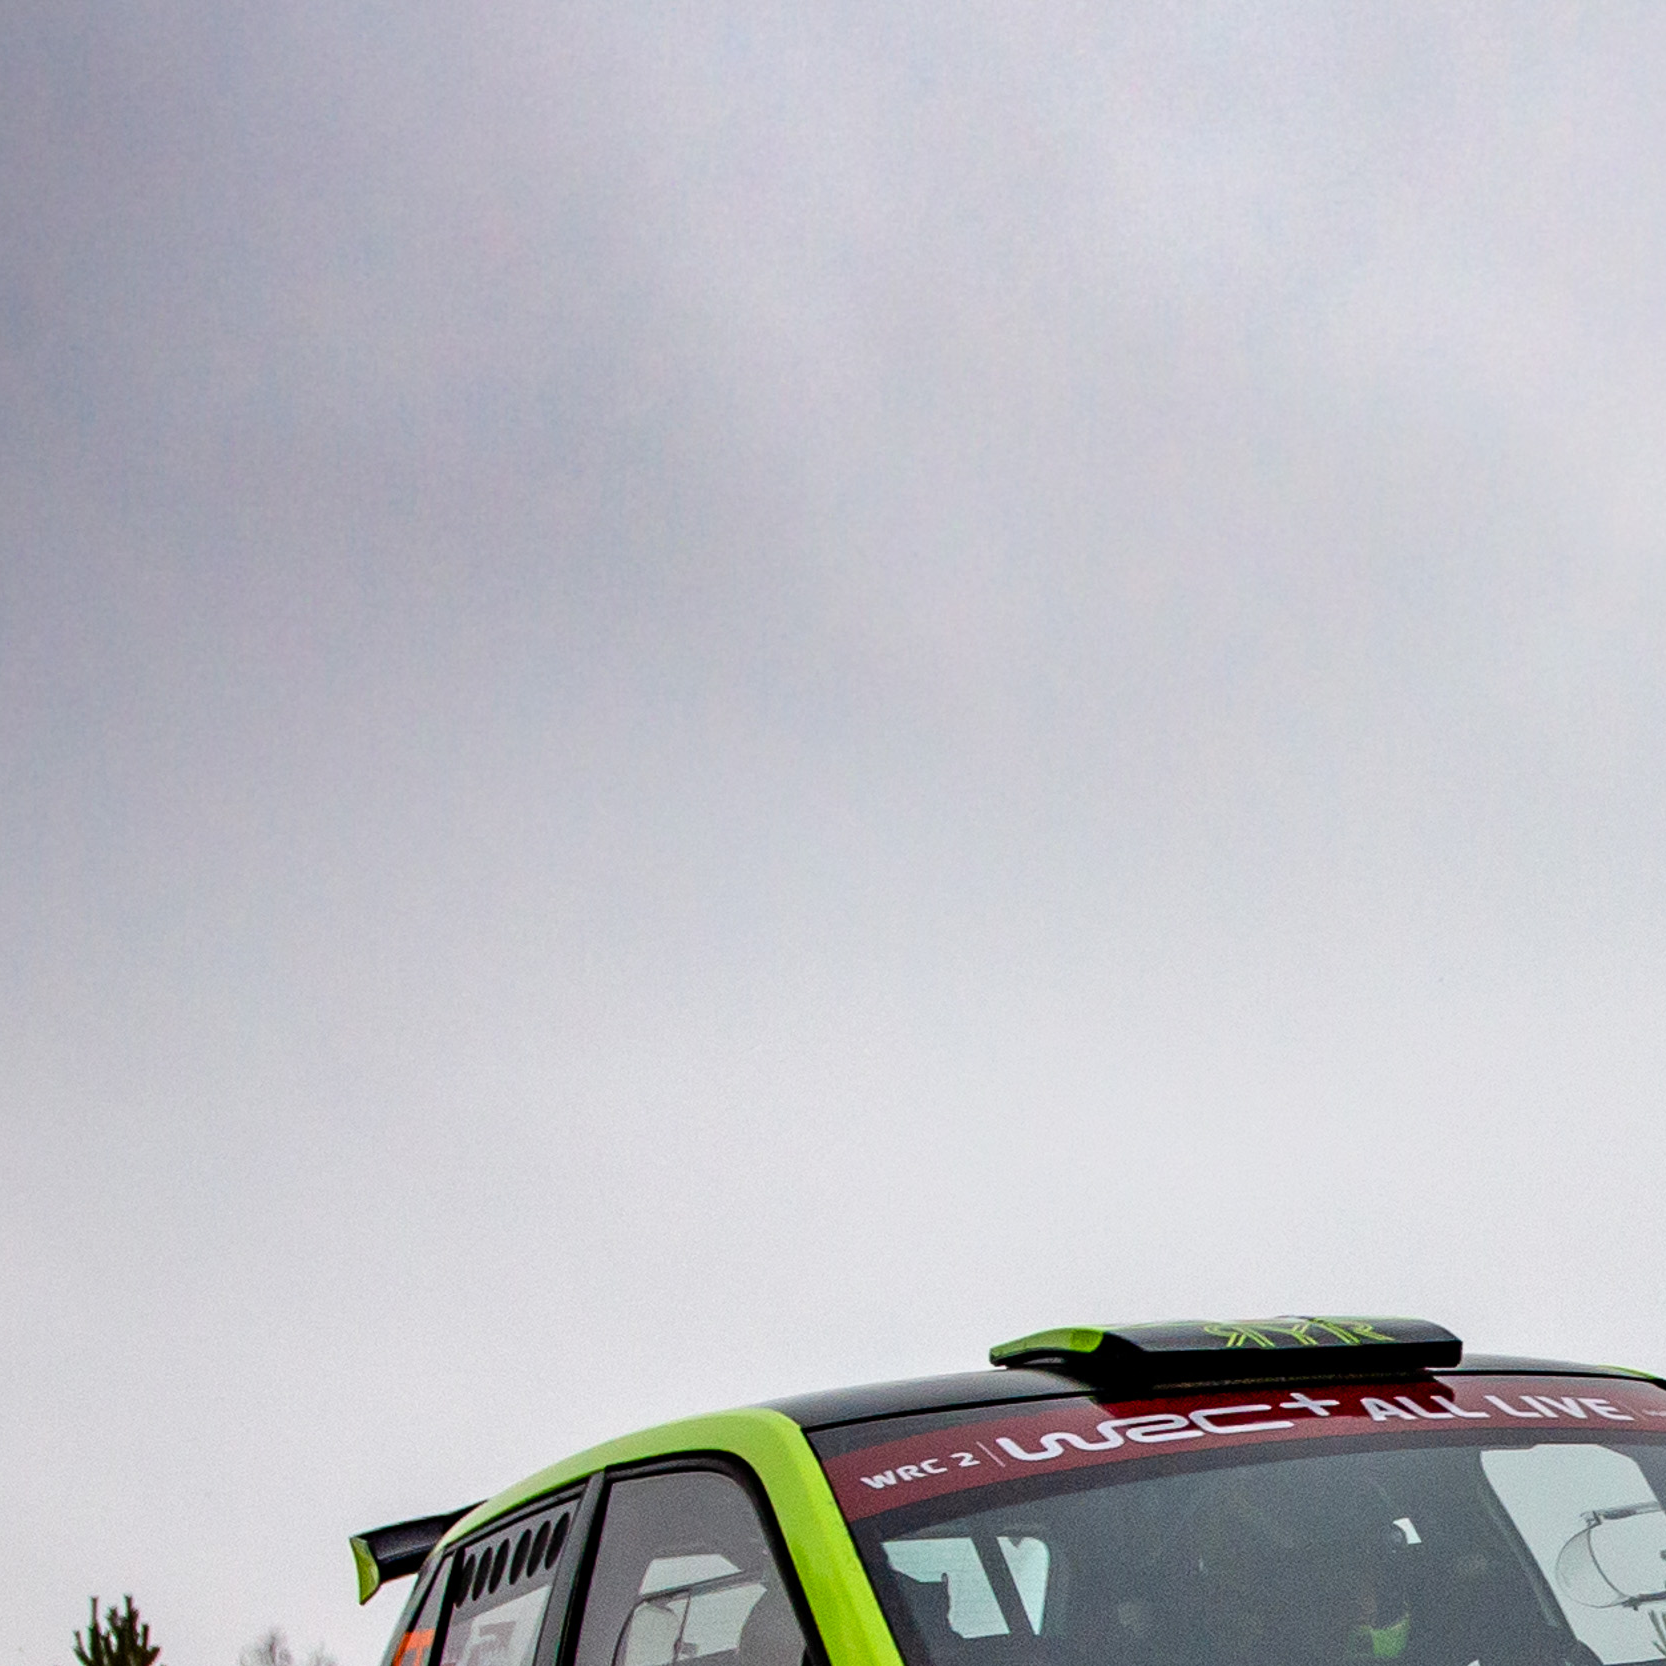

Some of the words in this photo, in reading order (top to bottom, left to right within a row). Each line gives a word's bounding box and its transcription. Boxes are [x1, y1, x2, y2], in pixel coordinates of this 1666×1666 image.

[860, 1459, 947, 1490] WRC
[949, 1452, 981, 1468] 2
[1361, 1396, 1490, 1421] ALL
[1483, 1395, 1636, 1421] LIVE
